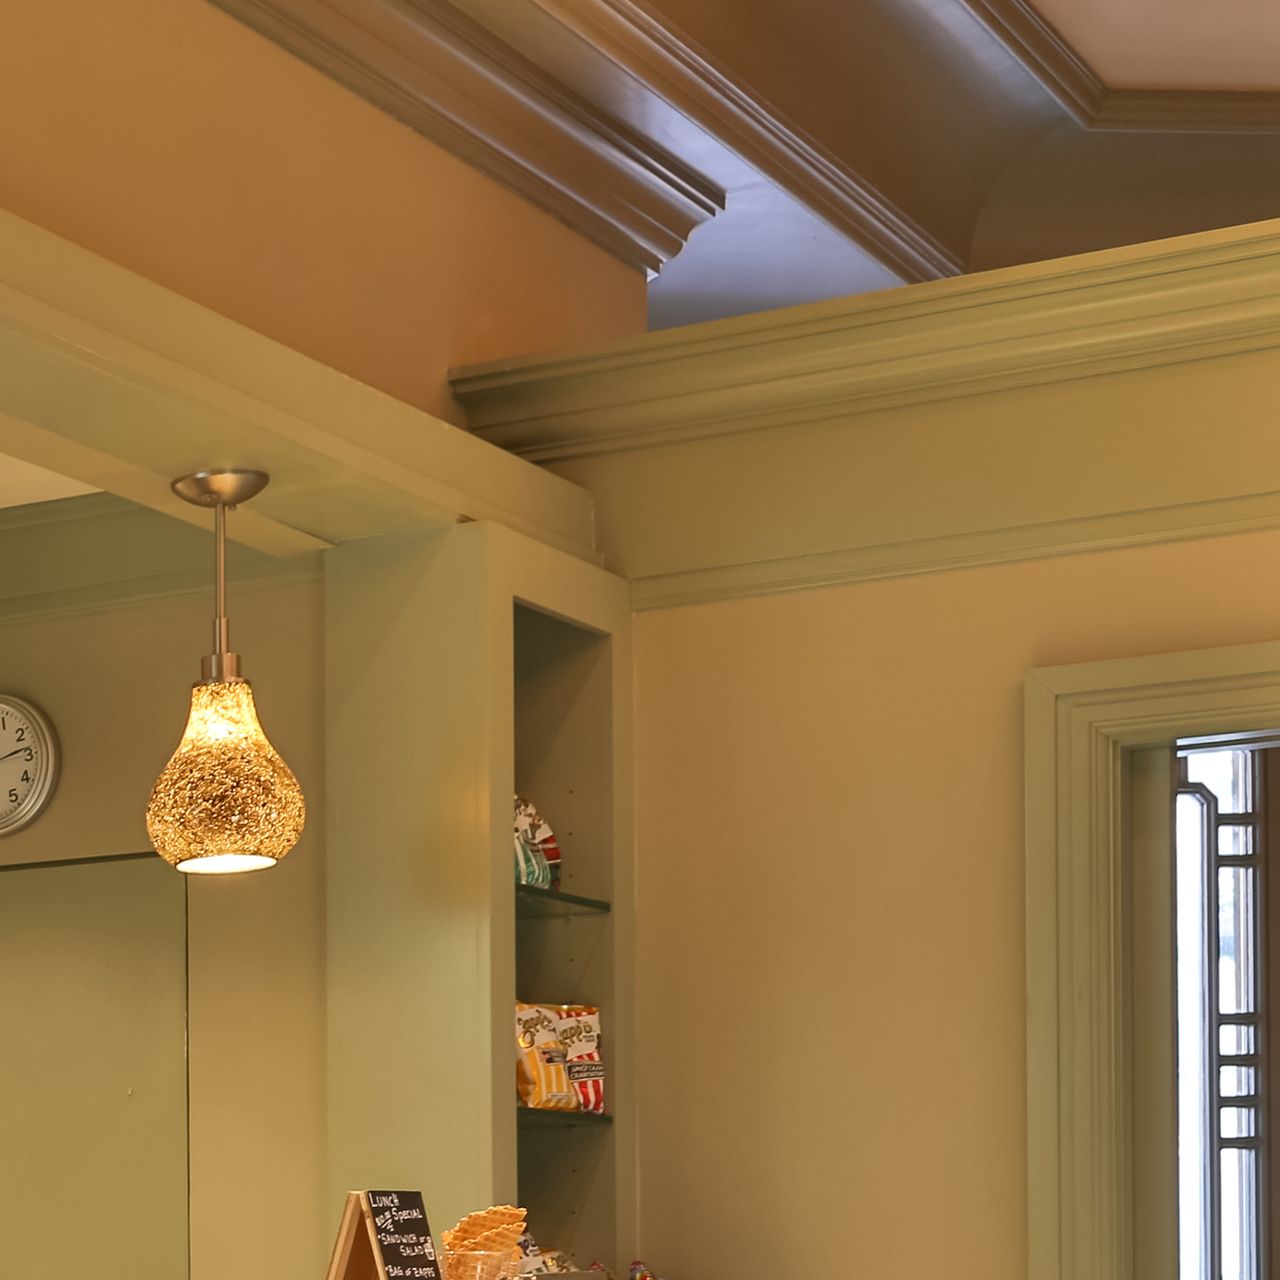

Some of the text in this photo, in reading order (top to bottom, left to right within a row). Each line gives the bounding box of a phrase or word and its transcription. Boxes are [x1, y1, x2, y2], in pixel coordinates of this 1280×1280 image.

[1, 717, 6, 730] 1
[15, 727, 25, 742] 2
[23, 747, 34, 762] 3
[20, 769, 30, 784] 4
[8, 788, 18, 803] 5
